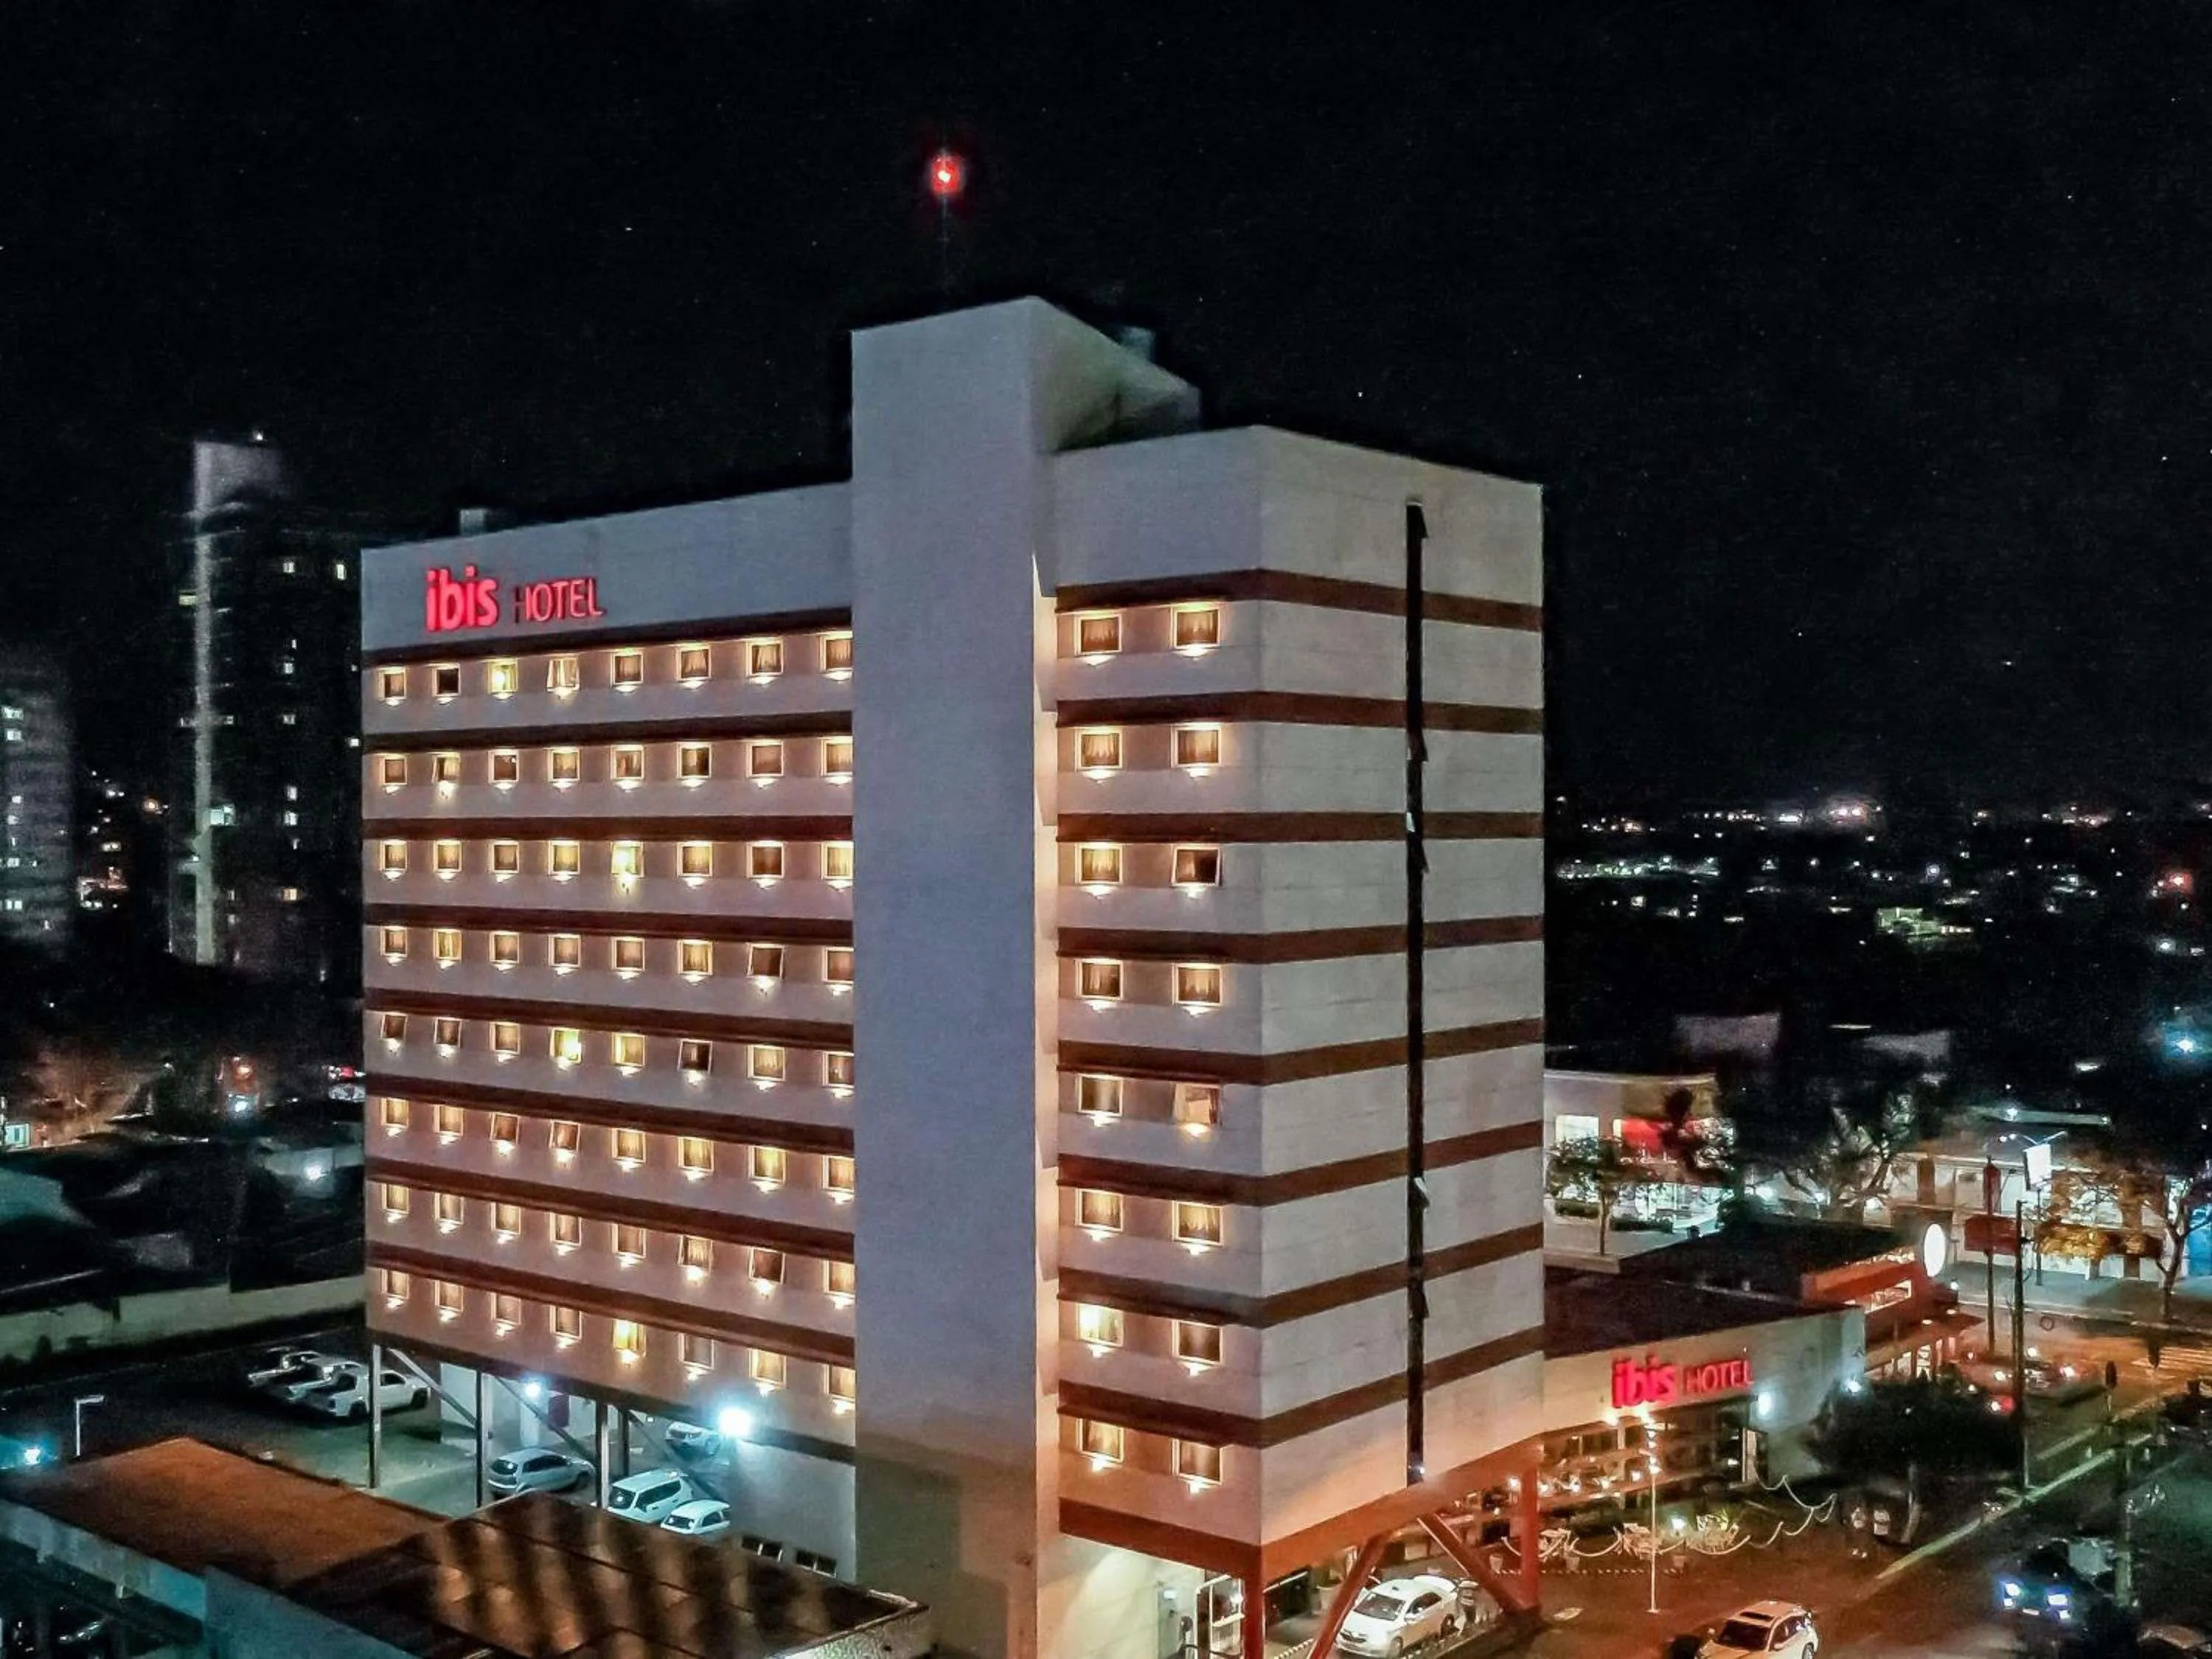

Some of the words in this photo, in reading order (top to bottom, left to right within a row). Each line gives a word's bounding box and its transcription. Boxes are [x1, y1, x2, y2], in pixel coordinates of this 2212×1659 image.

[426, 565, 499, 632] ibis
[513, 577, 605, 623] HOTEL
[1613, 1354, 1677, 1408] ibis
[1684, 1359, 1754, 1394] HOTEL
